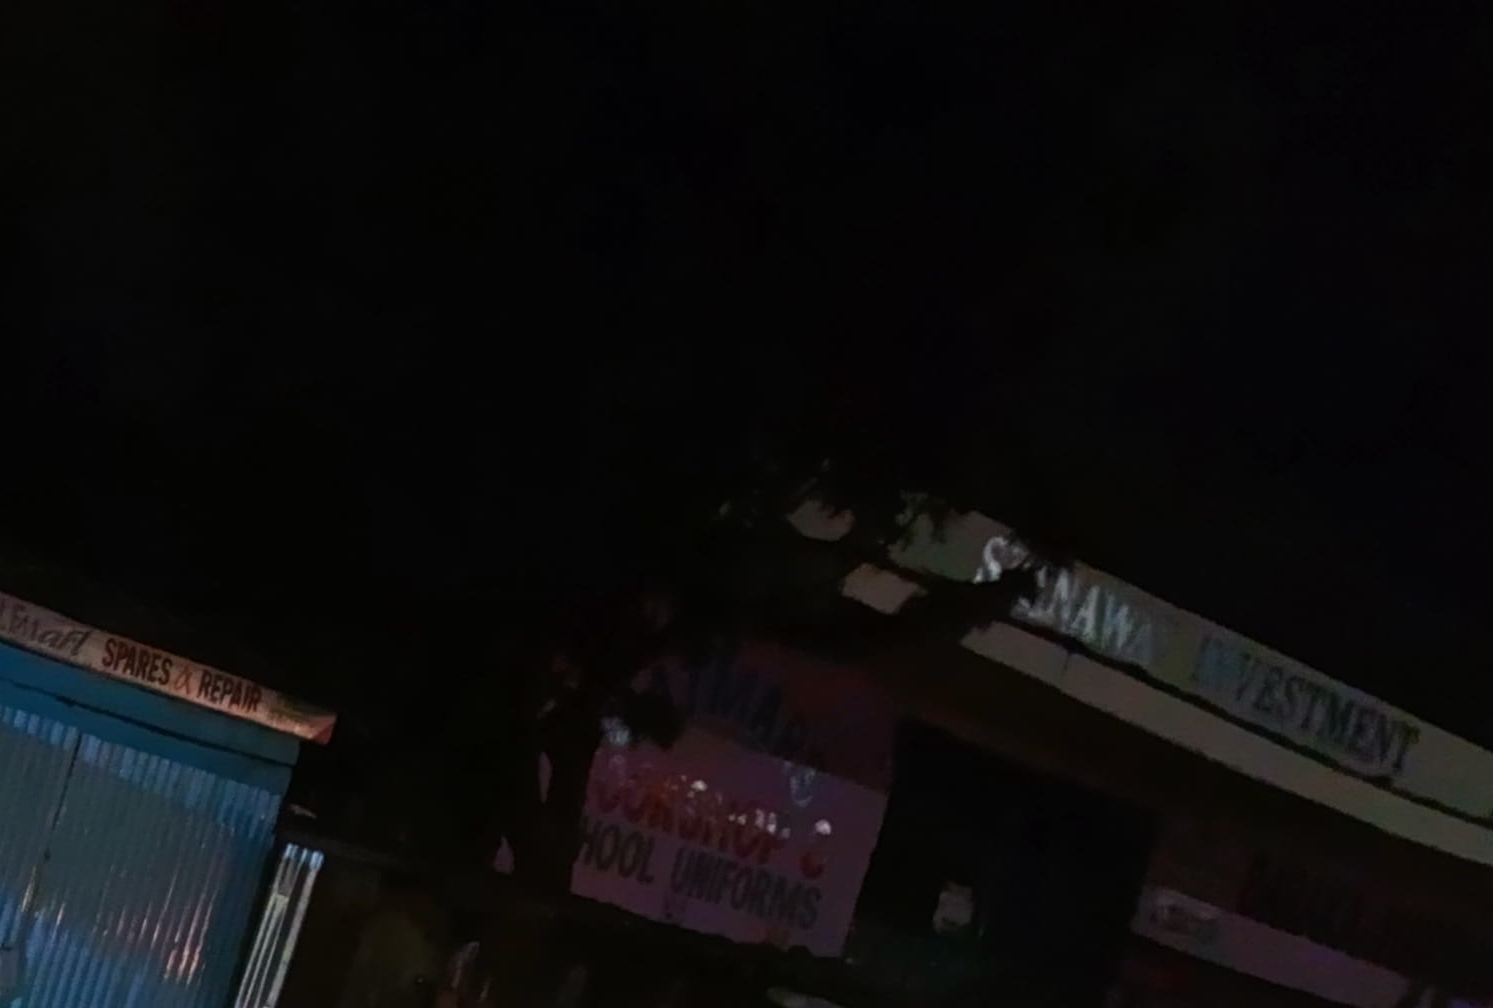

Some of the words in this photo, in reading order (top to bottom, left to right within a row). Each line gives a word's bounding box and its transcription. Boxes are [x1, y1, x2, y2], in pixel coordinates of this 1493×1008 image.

[101, 637, 173, 686] SPARES
[197, 669, 263, 713] REPAIR
[670, 845, 823, 930] UNIFORMS
